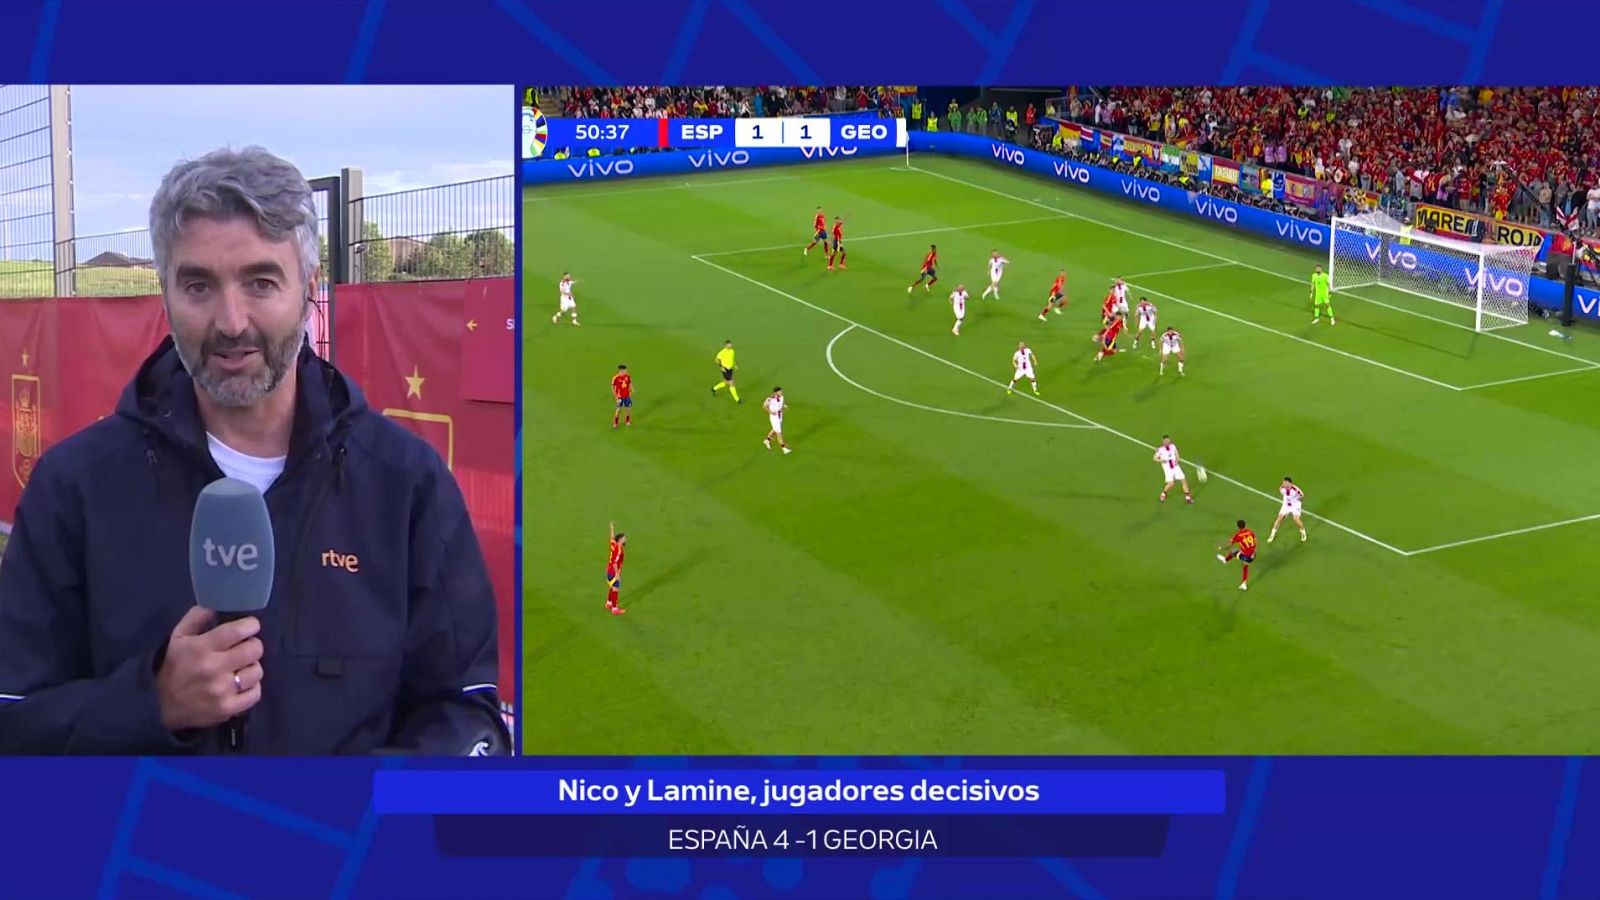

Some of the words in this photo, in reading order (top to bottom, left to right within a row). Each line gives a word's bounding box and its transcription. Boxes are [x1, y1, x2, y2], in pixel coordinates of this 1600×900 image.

[688, 149, 750, 168] vivo
[991, 143, 1025, 165] vivo
[567, 159, 634, 178] vivo
[1053, 160, 1090, 184] vivo
[1121, 178, 1161, 203] vivo
[1195, 198, 1238, 224] vivo
[1275, 216, 1323, 246] vivo
[1365, 242, 1418, 270] vvo
[202, 537, 258, 571] tve
[321, 549, 359, 573] rtve
